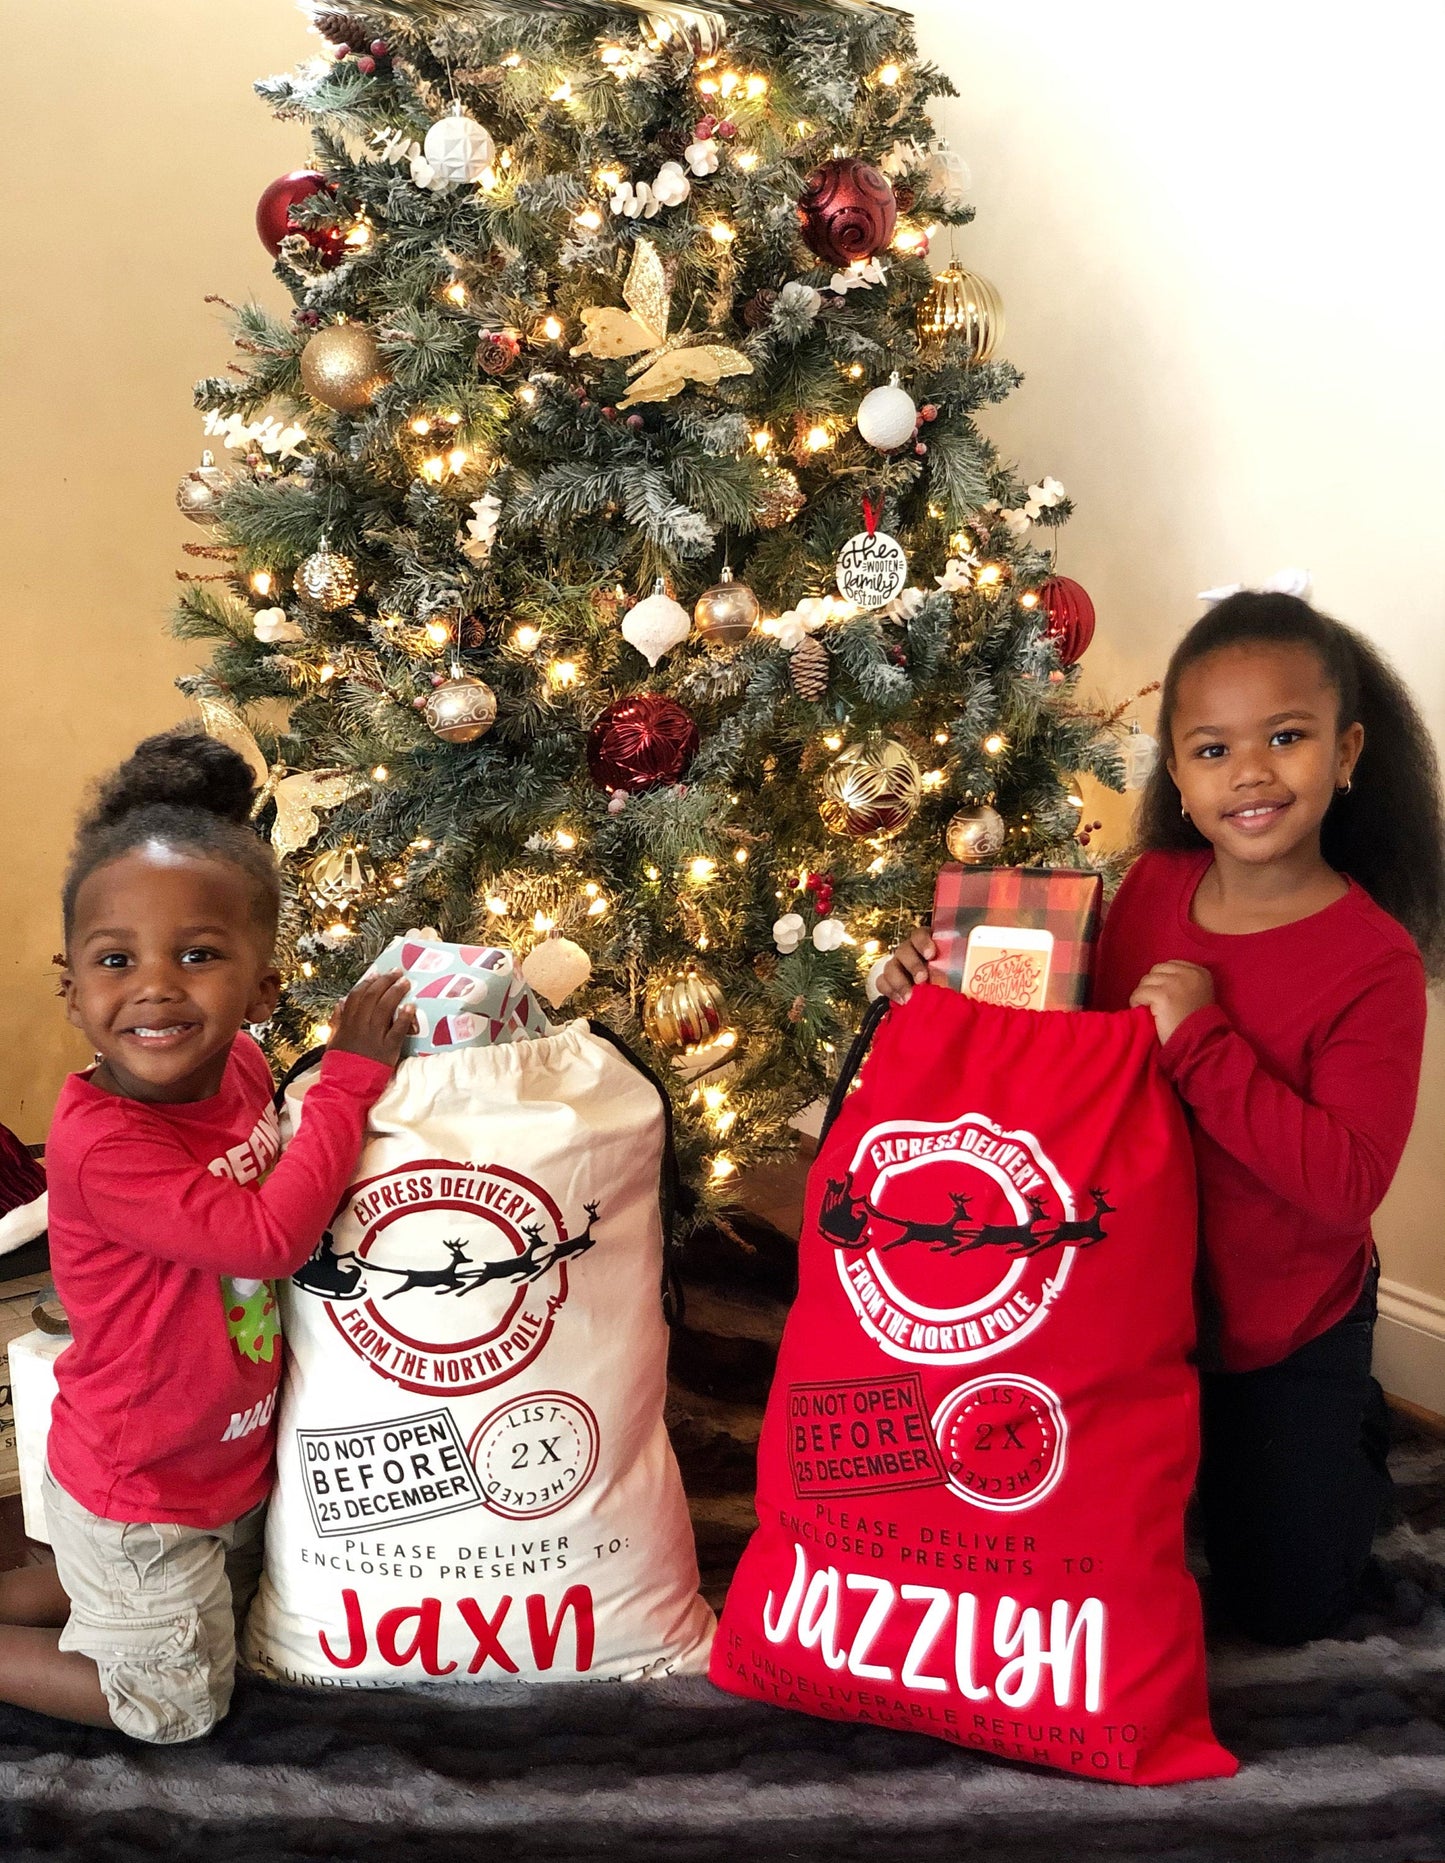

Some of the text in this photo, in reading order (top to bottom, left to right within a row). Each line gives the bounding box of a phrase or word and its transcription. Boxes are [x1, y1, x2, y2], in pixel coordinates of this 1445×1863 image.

[843, 570, 900, 600] family
[867, 560, 899, 573] WOOTEN
[868, 594, 882, 606] 2011
[982, 958, 1024, 983] Merry
[870, 1128, 1046, 1194] EXPRESS DELIVERY
[353, 1176, 536, 1227] EXPRESS DELIVERY
[847, 1258, 1037, 1351] FROM THE NORTH POLE
[341, 1308, 543, 1383] FROM THE NORTH POLE
[508, 1406, 561, 1428] LIST
[791, 1386, 913, 1417] DO NOT OPEN
[976, 1387, 1032, 1408] LIST
[307, 1421, 447, 1462] DO NOT OPEN
[794, 1413, 926, 1453] BEFORE
[312, 1445, 462, 1495] BEFORE
[796, 1448, 932, 1482] 25 DECEMBER
[949, 1458, 1042, 1493] CHECKED
[318, 1475, 470, 1522] 25 DECEMBER
[487, 1468, 576, 1506] CHECKED
[345, 1536, 569, 1560] PLEASE DELIVER
[779, 1510, 884, 1558] ENCLOSED
[901, 1547, 1033, 1575] PRESENTS
[815, 1503, 1036, 1552] PLEASE DELIVER
[301, 1538, 630, 1579] ENCLOSED PRESENTS TO:
[318, 1584, 595, 1676] Jaxn
[763, 1542, 1105, 1712] Jazzlyn
[258, 1650, 274, 1667] IF
[726, 1652, 801, 1704] SANTA
[943, 1728, 1049, 1760] NORTH
[728, 1628, 743, 1650] IF
[751, 1650, 958, 1724] UNDELIVERABLE
[973, 1715, 1086, 1745] RETURN
